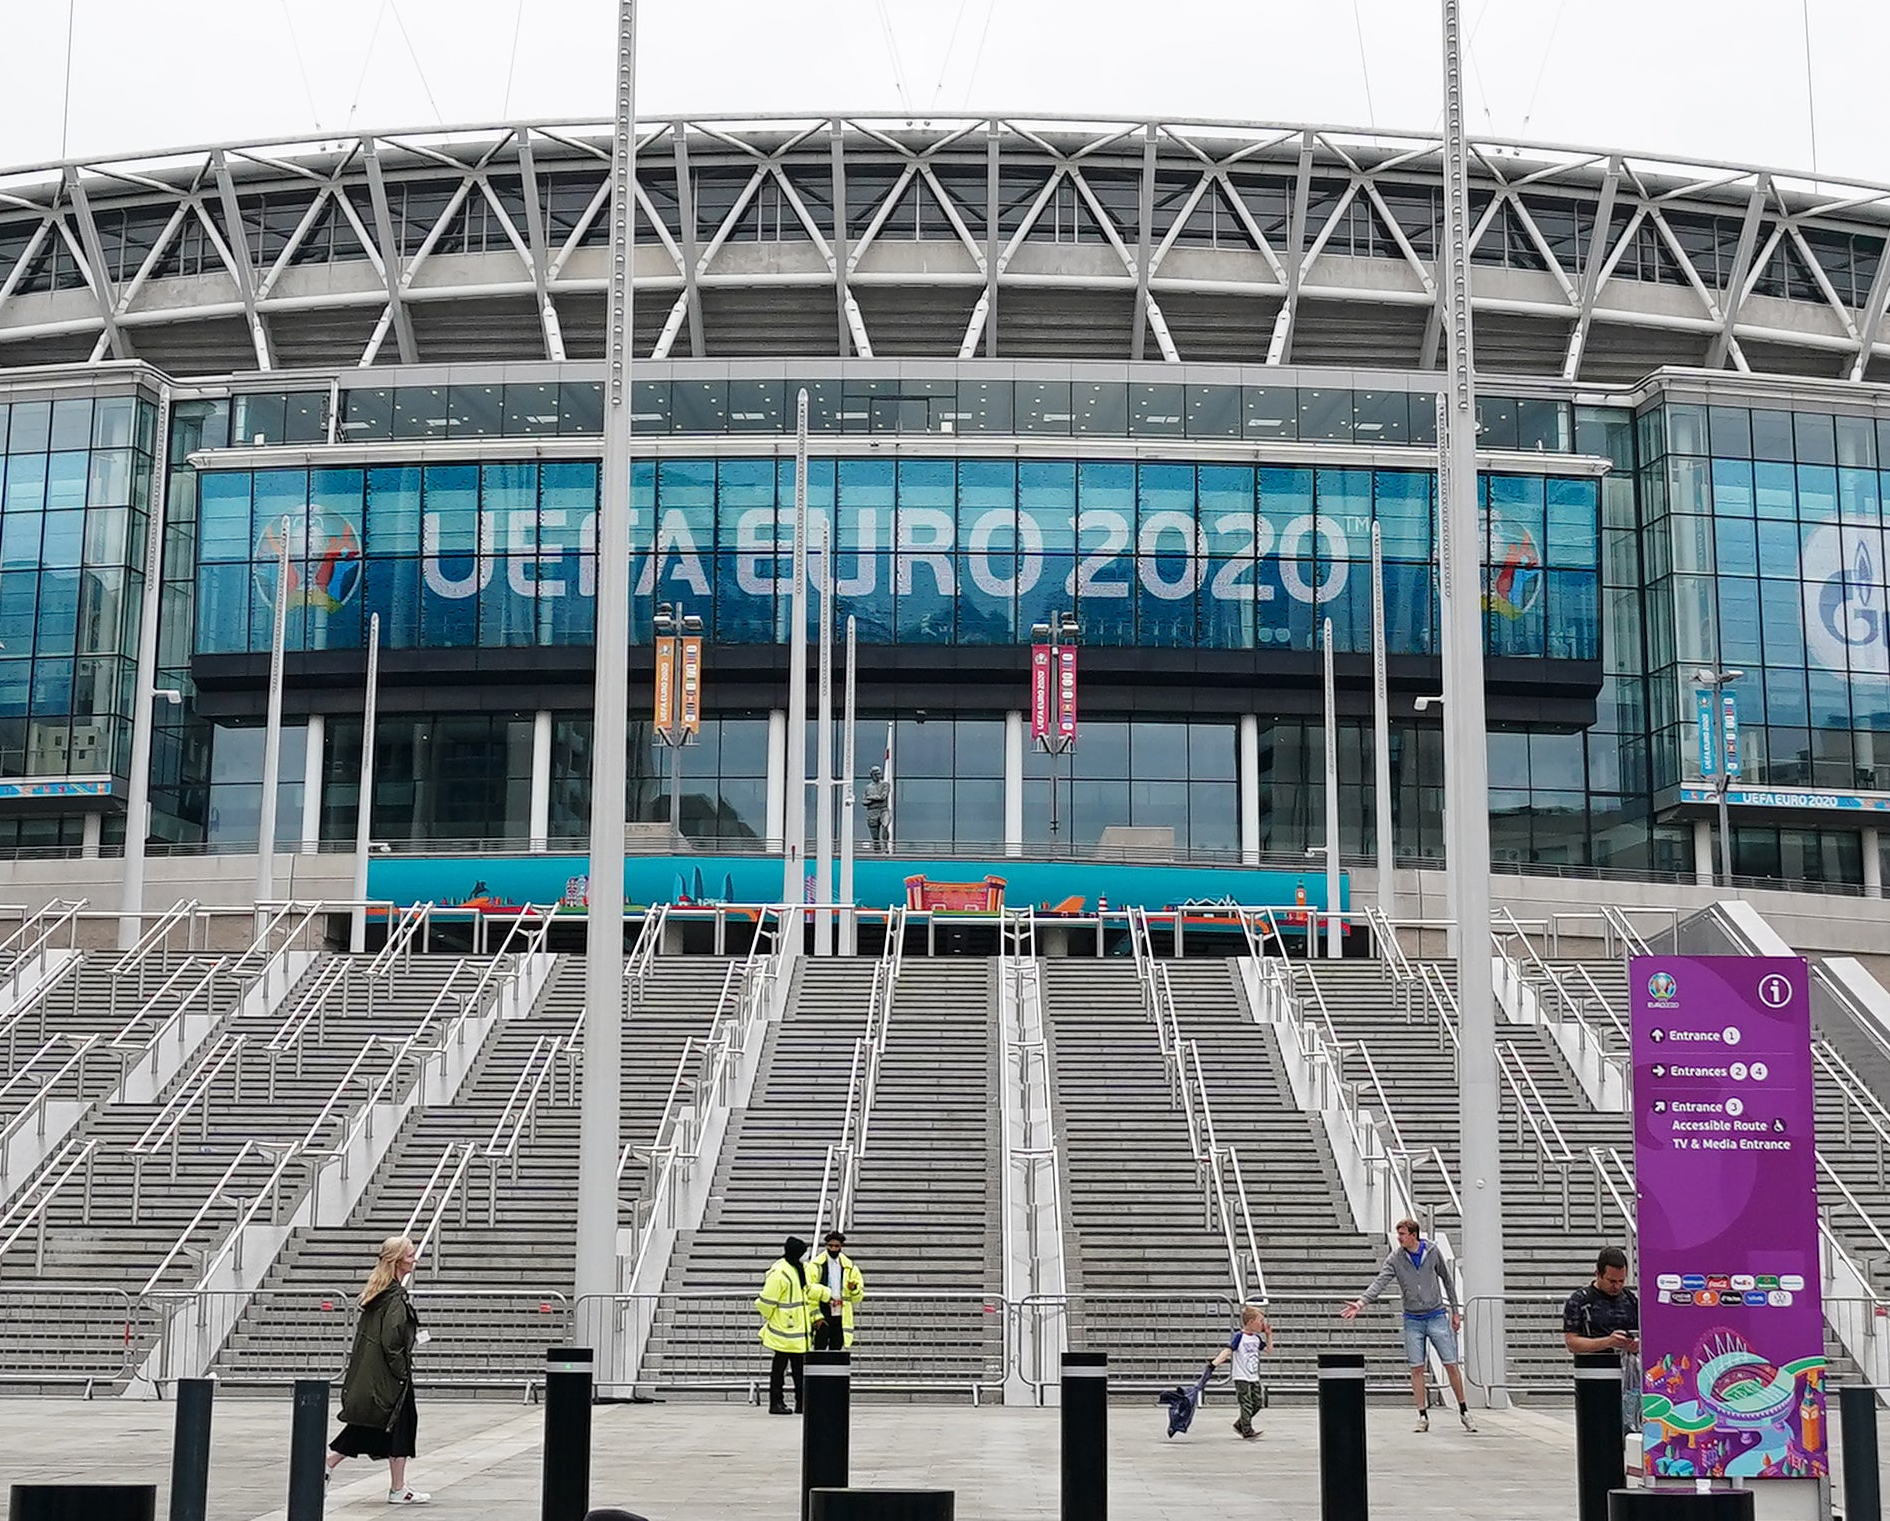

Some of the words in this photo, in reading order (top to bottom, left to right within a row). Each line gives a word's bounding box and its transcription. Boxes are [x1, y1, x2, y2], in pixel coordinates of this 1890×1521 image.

[735, 507, 1043, 598] EURO
[1742, 793, 1775, 804] UEFA
[1775, 795, 1808, 806] EURO
[1809, 796, 1838, 807] 2020
[1669, 1030, 1721, 1041] Entrance
[1670, 1066, 1727, 1077] Entrances
[1672, 1102, 1723, 1112] Entrance
[1672, 1120, 1731, 1131] Accessible
[1733, 1120, 1768, 1131] Route
[1673, 1138, 1688, 1149] TV
[1690, 1139, 1700, 1149] &
[1703, 1139, 1737, 1149] Media
[1740, 1139, 1791, 1150] Entrance
